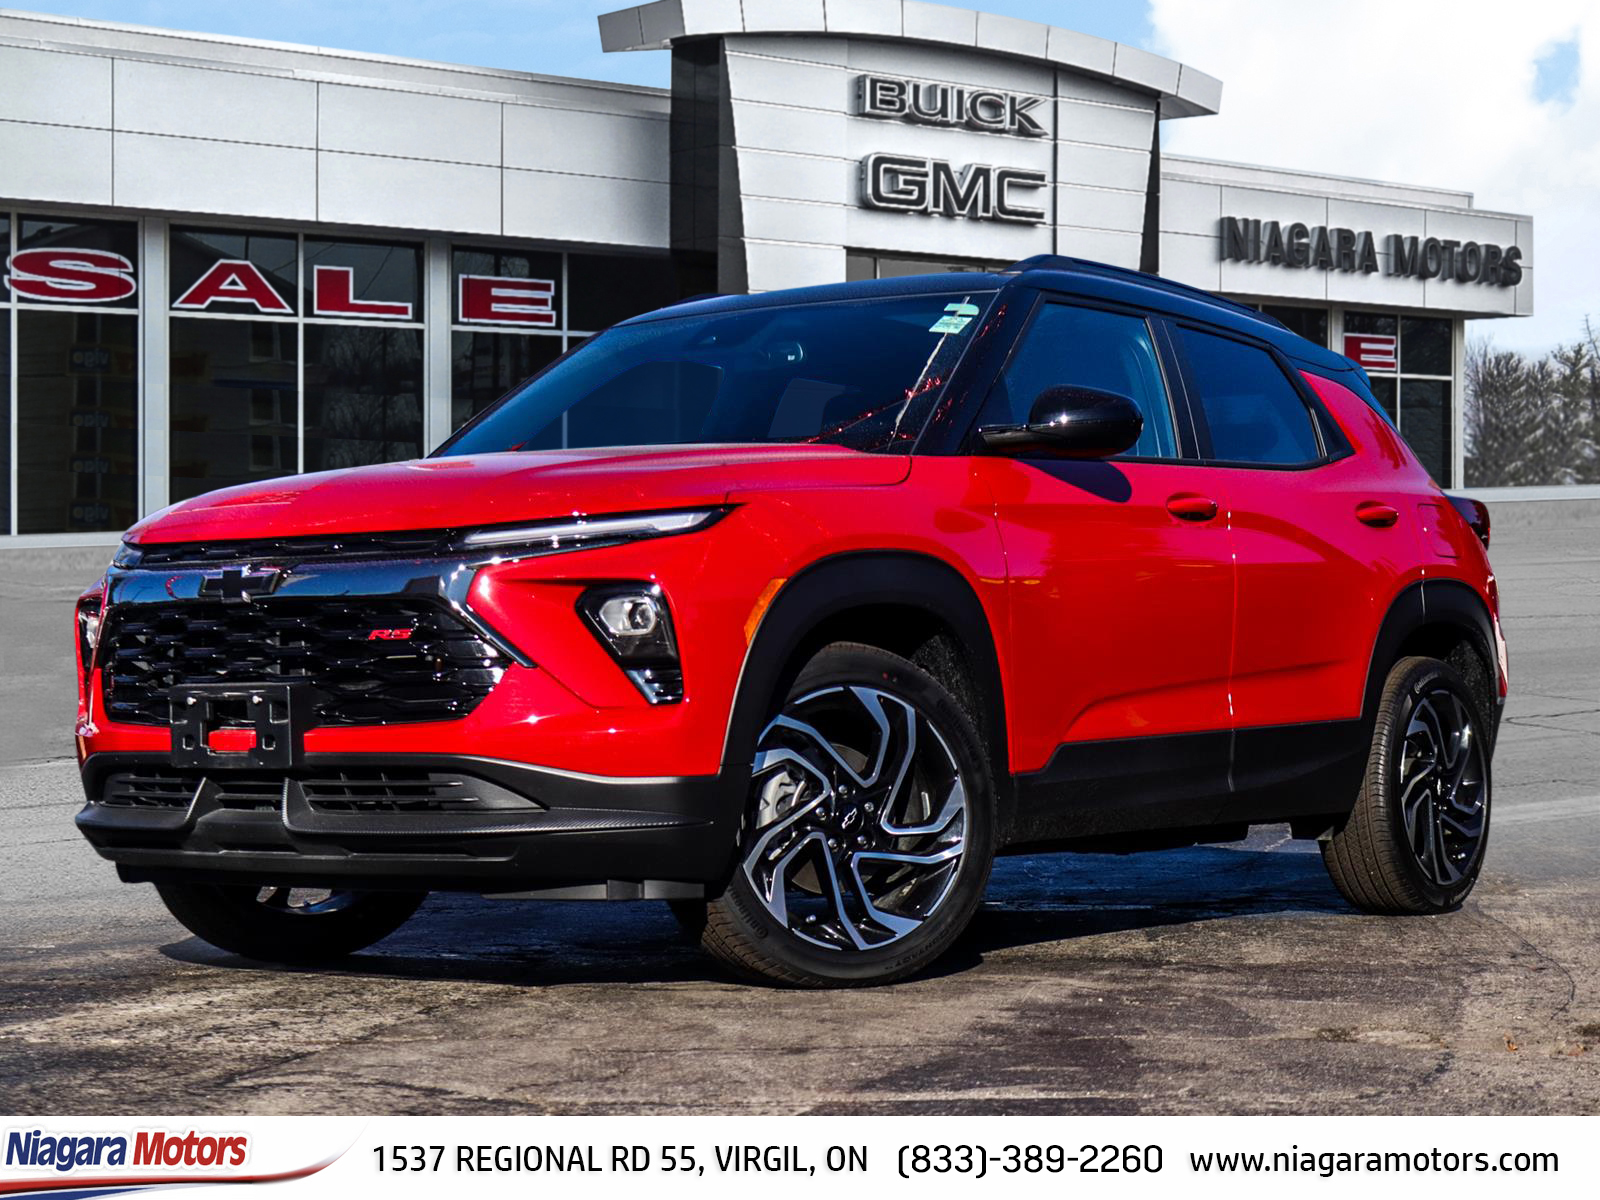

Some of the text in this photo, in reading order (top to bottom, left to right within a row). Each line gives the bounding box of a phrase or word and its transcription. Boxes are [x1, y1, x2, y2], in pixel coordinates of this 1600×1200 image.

[857, 74, 1049, 137] BUICK
[861, 152, 1047, 225] GMC
[4, 247, 557, 327] SALE
[1220, 216, 1523, 287] NIAGARA MOTORS
[368, 628, 414, 641] RS
